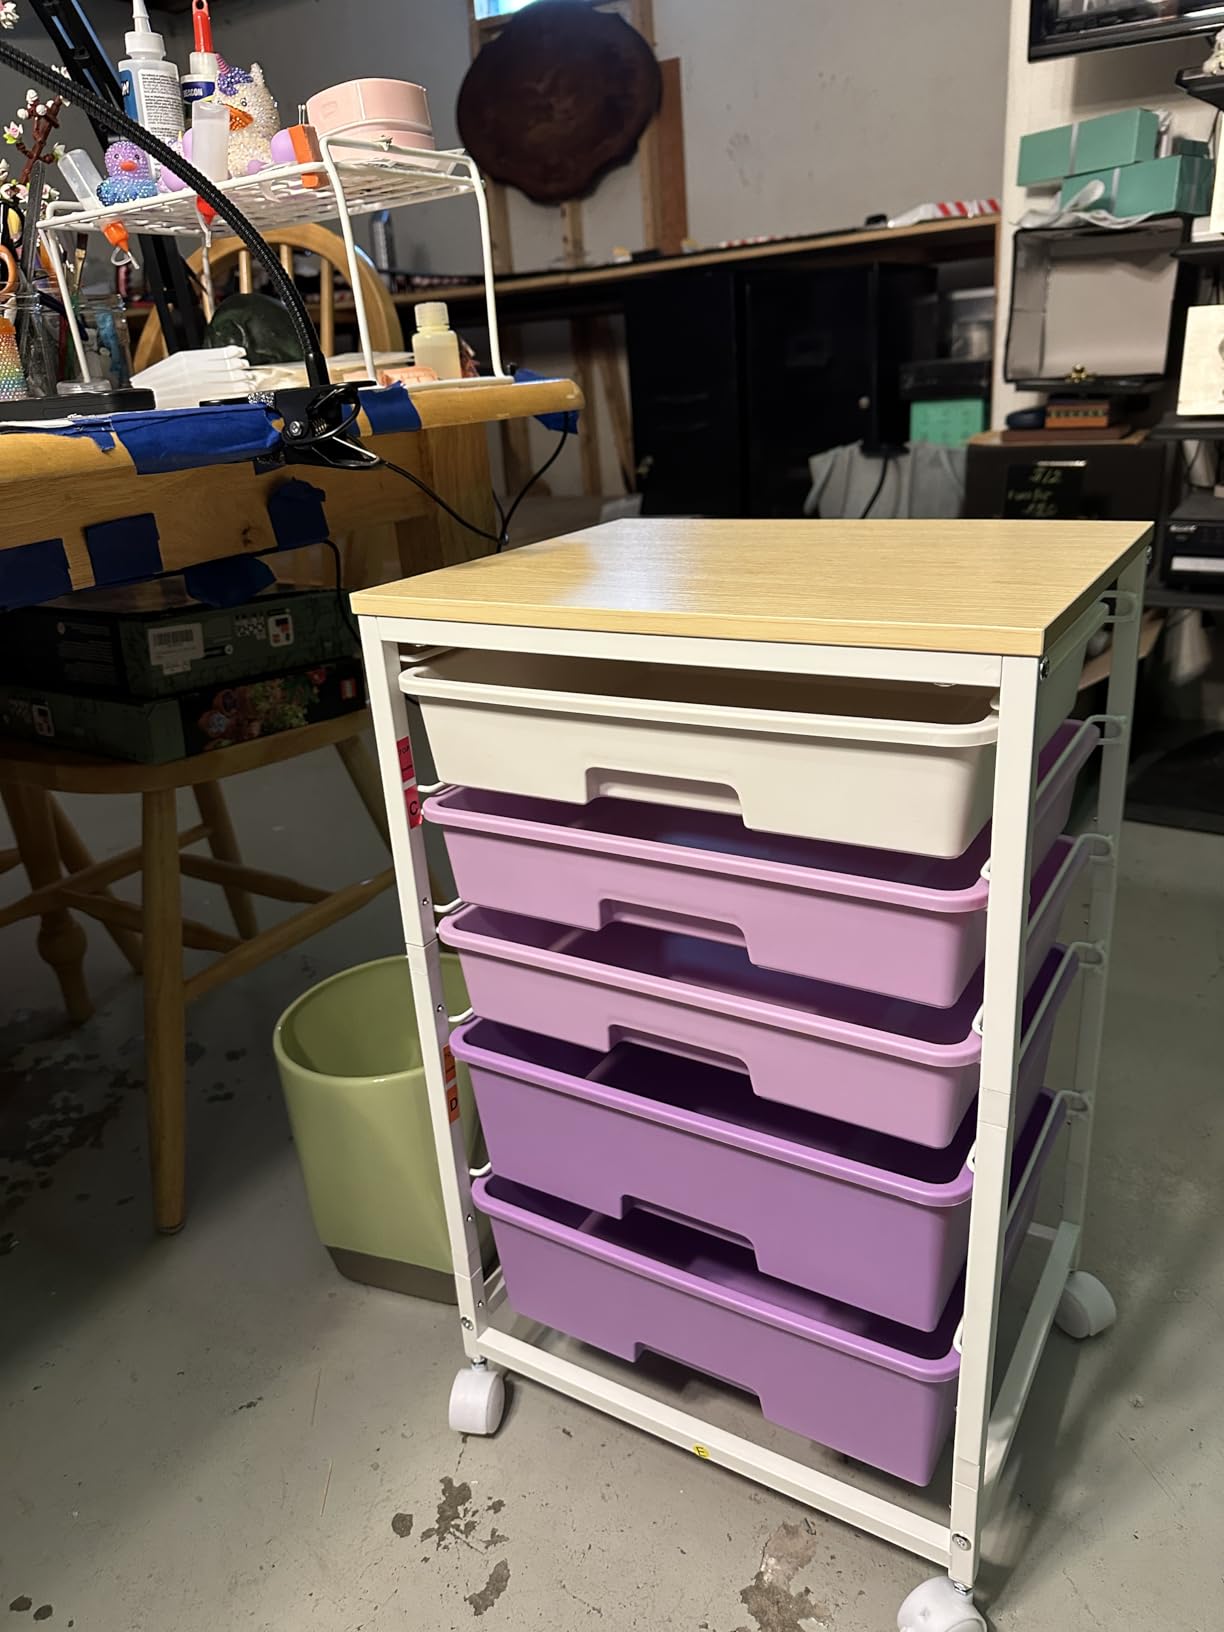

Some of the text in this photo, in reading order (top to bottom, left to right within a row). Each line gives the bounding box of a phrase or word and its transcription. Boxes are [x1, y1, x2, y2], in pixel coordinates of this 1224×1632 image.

[410, 801, 418, 815] C
[450, 1097, 458, 1112] D
[696, 1446, 705, 1457] E
